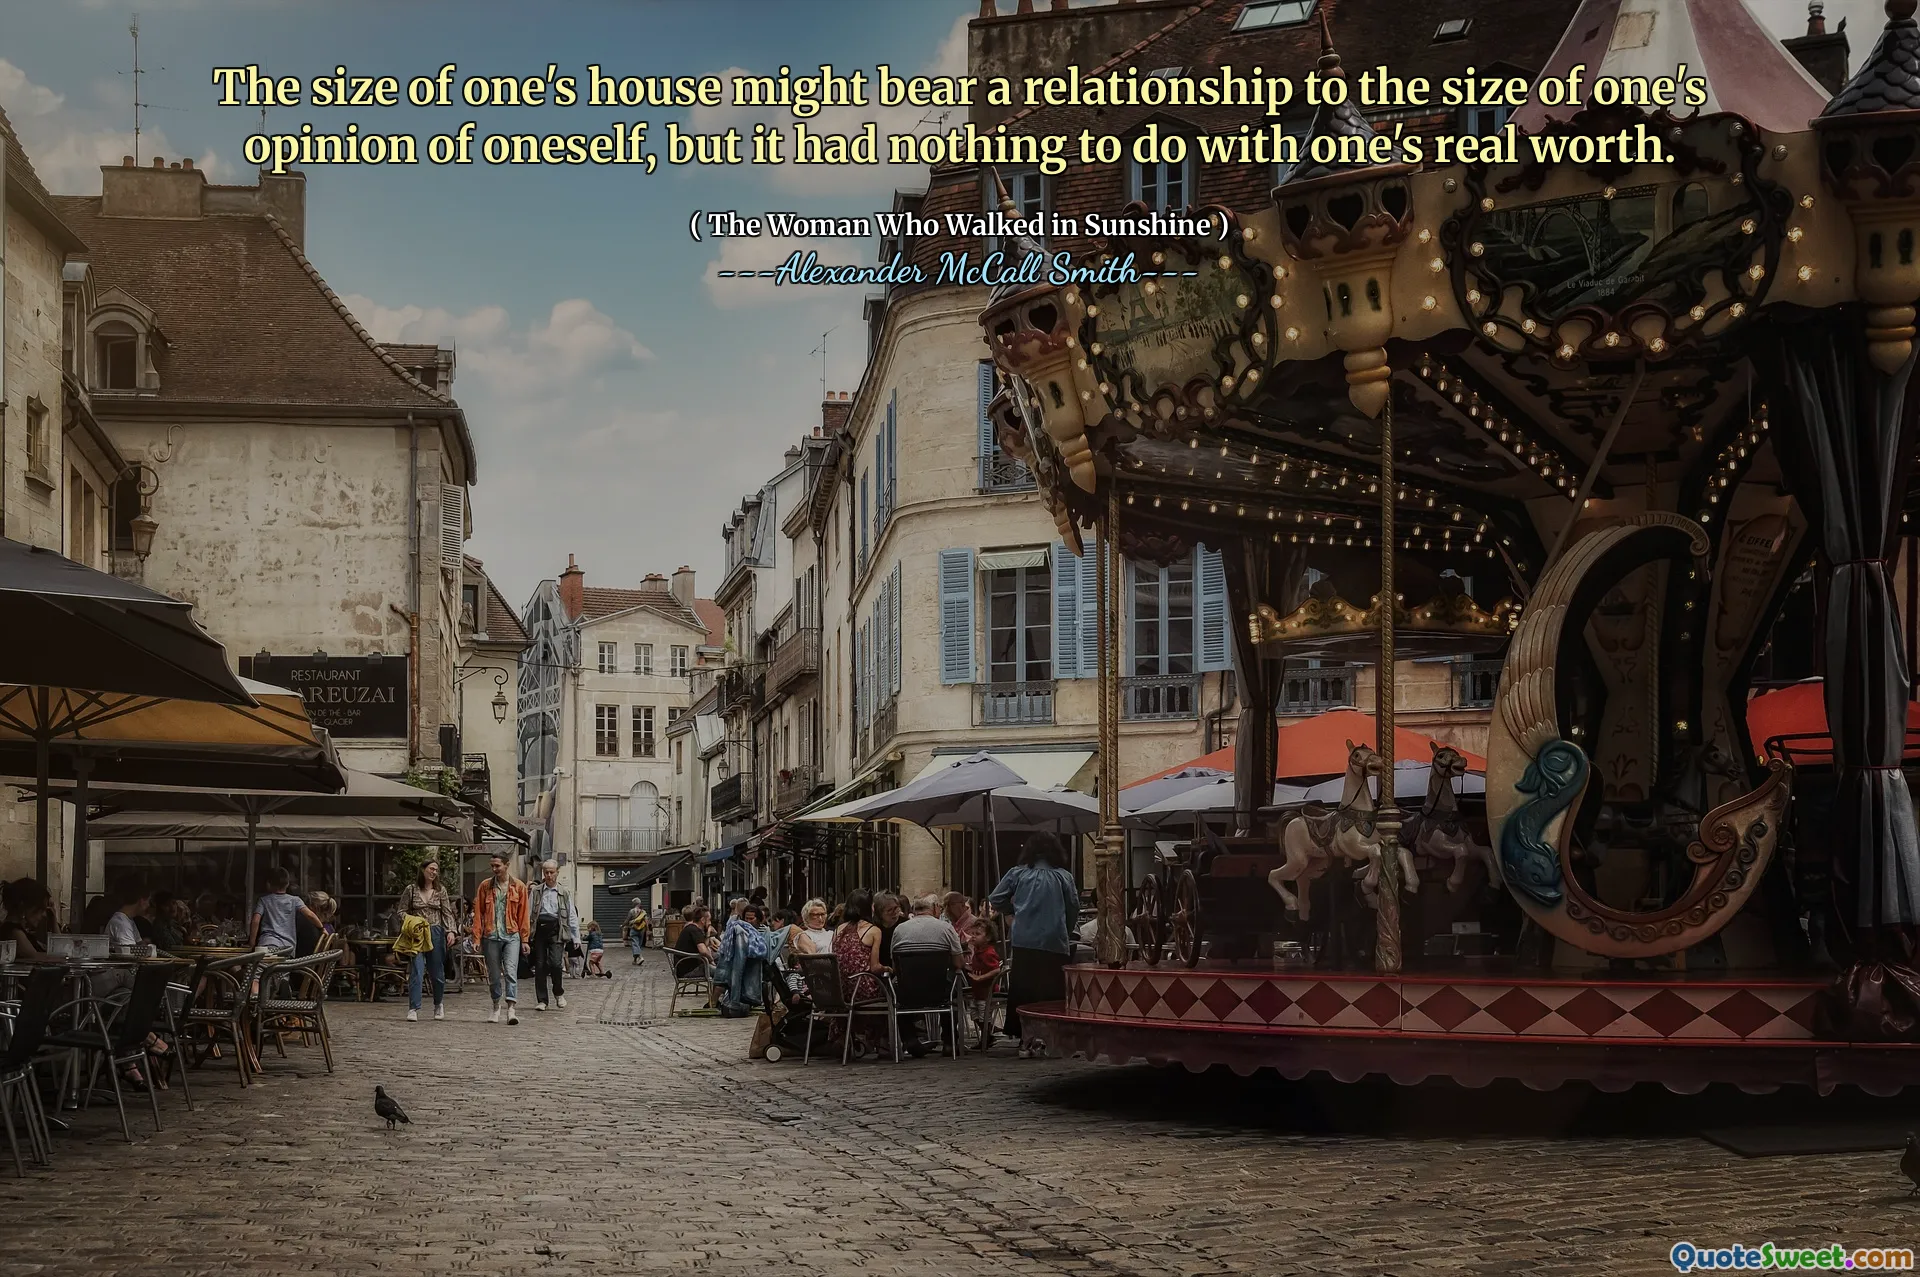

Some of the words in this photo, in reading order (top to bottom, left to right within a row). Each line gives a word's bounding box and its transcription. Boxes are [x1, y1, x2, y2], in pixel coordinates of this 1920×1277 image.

[1578, 279, 1602, 287] Viaduc
[1606, 277, 1615, 285] de
[1597, 288, 1615, 297] 1884
[291, 669, 361, 681] RESTAURANT
[285, 685, 396, 703] AREUZAI
[347, 709, 361, 717] BAR
[324, 718, 353, 726] GLACIER
